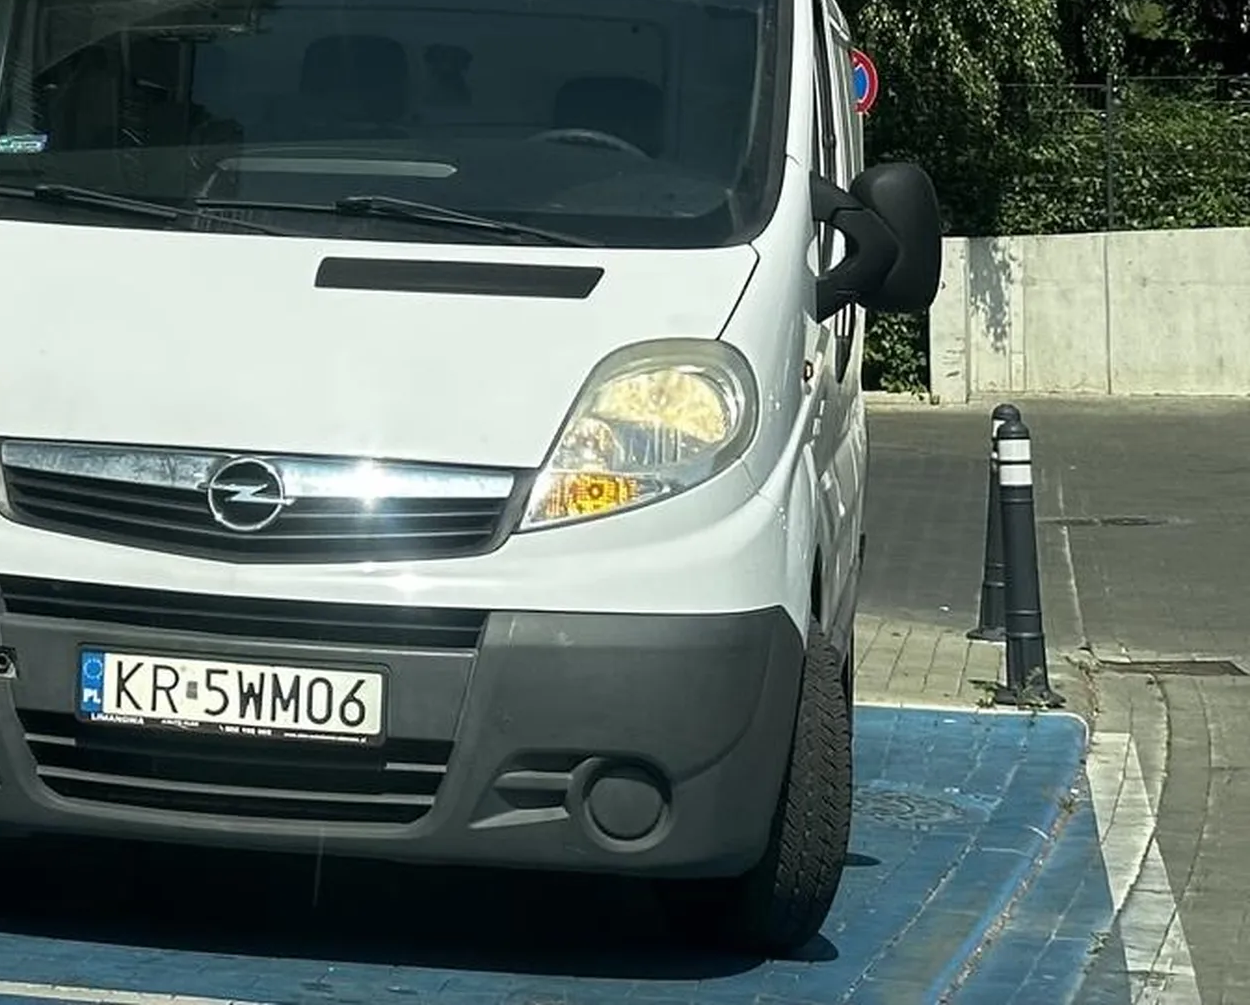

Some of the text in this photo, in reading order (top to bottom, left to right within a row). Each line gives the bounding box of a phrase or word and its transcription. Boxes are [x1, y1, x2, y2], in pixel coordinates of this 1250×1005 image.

[82, 687, 101, 704] PL
[115, 661, 366, 727] KR 5WM06
